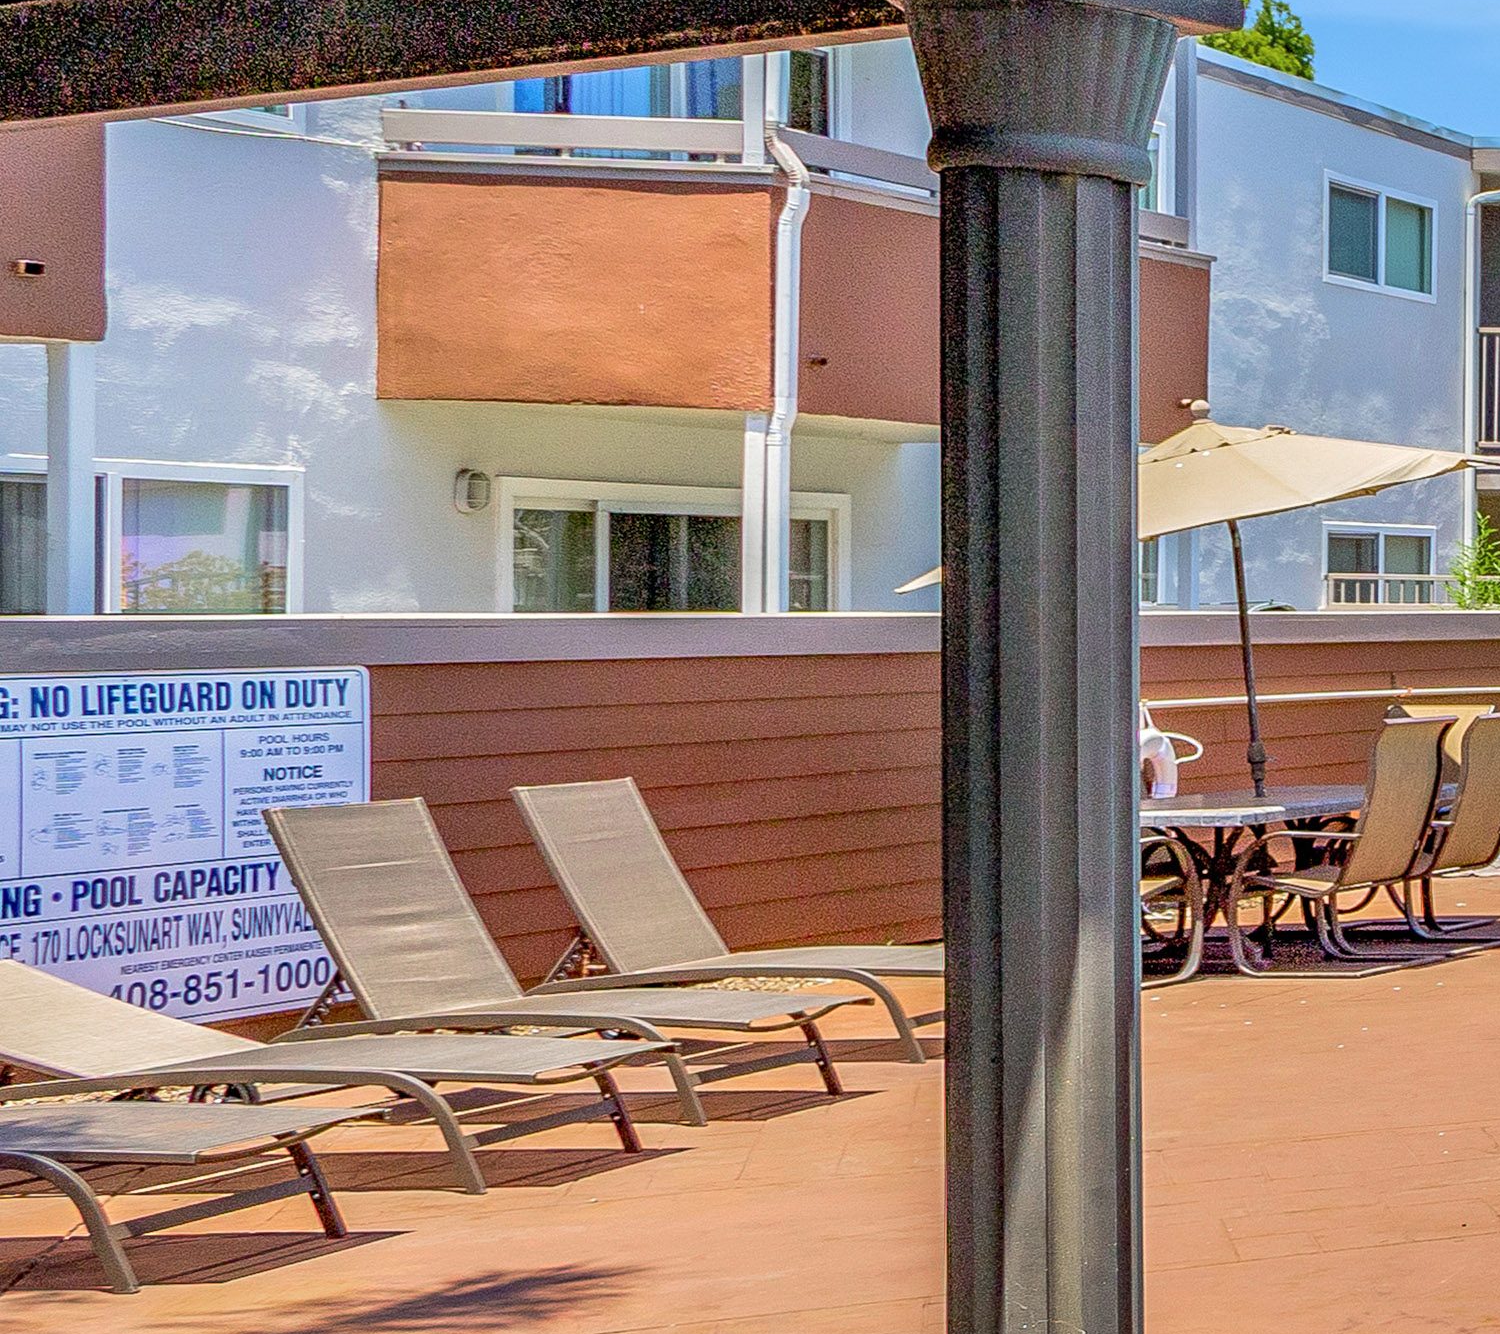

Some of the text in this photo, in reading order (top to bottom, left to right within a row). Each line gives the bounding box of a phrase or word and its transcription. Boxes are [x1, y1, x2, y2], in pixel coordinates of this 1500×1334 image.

[30, 685, 70, 718] NO
[81, 681, 232, 716] LIFEGUARD
[241, 679, 277, 710] ON
[285, 677, 350, 709] DUTY
[0, 710, 352, 733] MAY NOT USE THE POOL WITHOUT AN ADULT IN ATTENDANCE
[259, 733, 330, 745] POOL HOURS
[240, 744, 344, 758] 9:00 AM TO 9:00 PM
[263, 764, 323, 782] NOTICE
[233, 785, 273, 795] PERSONS
[71, 875, 143, 912] POOL
[154, 861, 281, 903] CAPACITY
[33, 930, 61, 965] 170
[67, 915, 183, 961] LOCKSUNART
[188, 911, 227, 948] WAY,
[231, 901, 317, 941] SUNNYVAL
[120, 960, 159, 975] NEAREST
[162, 955, 211, 970] EMERGENCY
[213, 951, 244, 964] CENTER
[245, 946, 272, 959] KAISER
